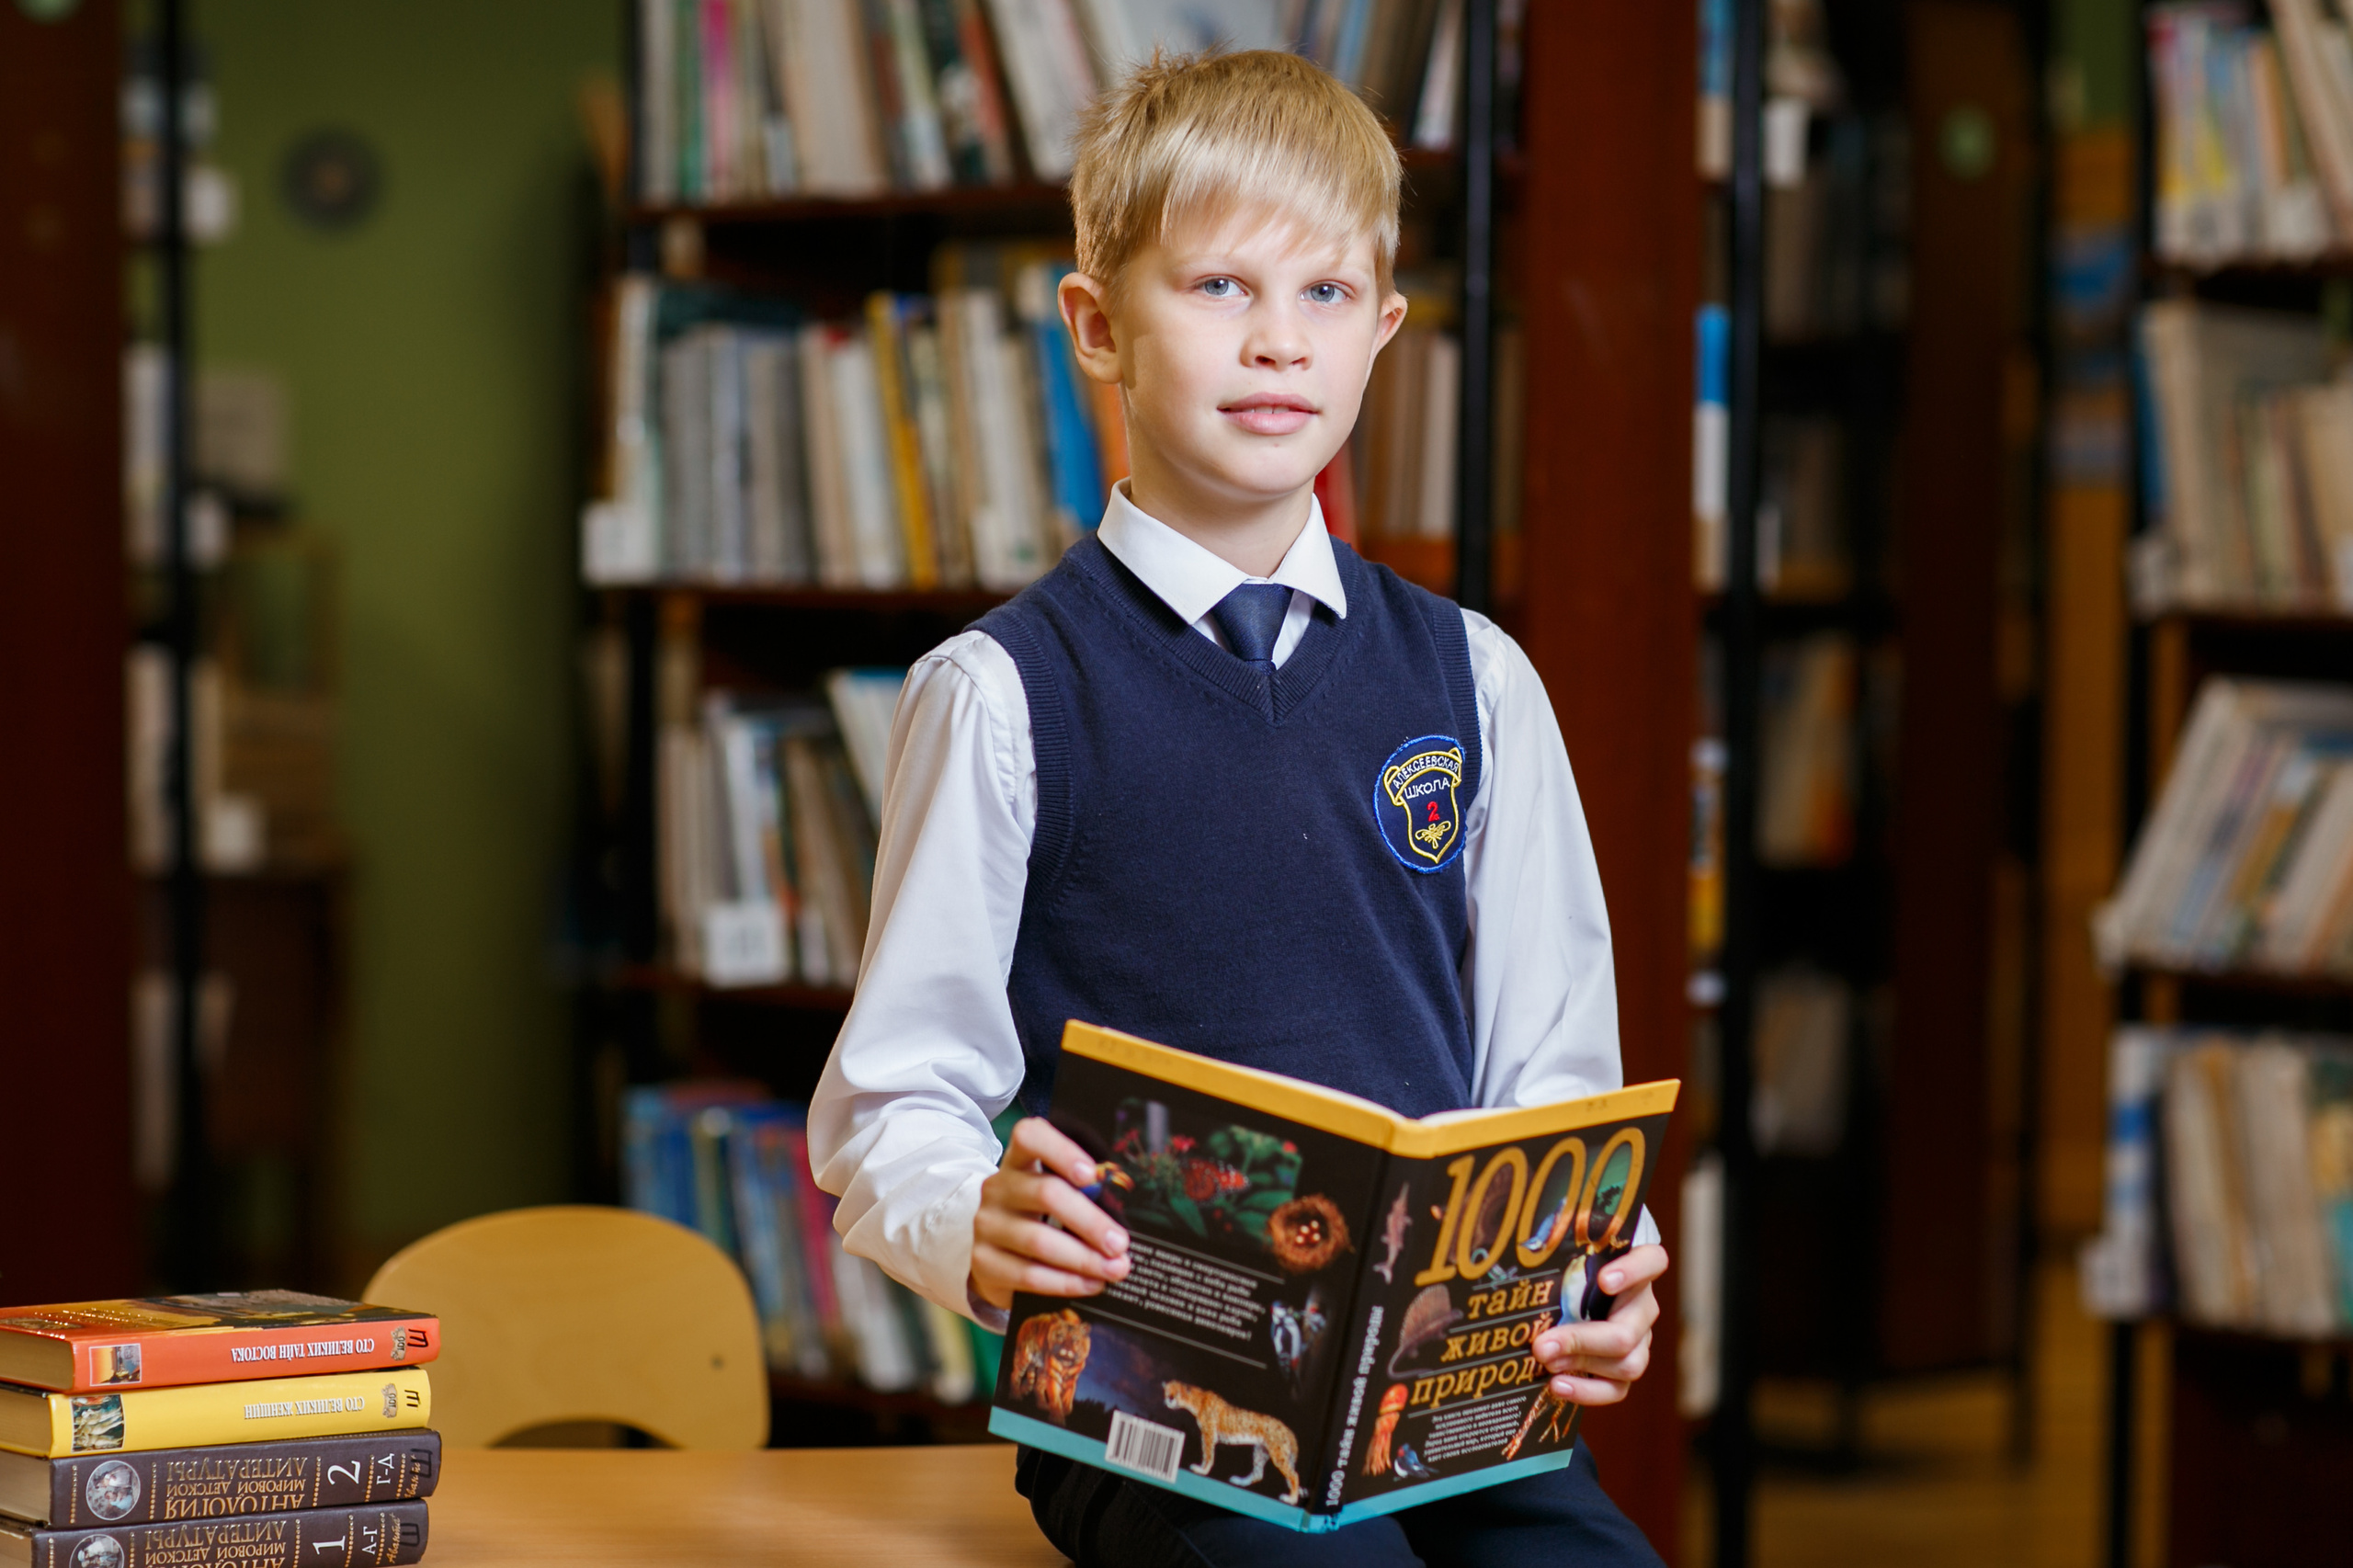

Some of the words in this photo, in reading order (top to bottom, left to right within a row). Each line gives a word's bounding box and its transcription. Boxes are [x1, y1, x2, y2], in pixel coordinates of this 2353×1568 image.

[1392, 756, 1460, 790] АЛЕКСЕЕВСКАЯ
[1404, 778, 1450, 800] ШКОЛА
[1427, 801, 1440, 823] 2
[1415, 1127, 1645, 1287] 1000
[1468, 1278, 1554, 1320] тайн
[355, 1337, 375, 1354] СТО
[1440, 1312, 1553, 1363] живой
[231, 1345, 276, 1364] ВОСТОКА
[278, 1343, 305, 1362] ТАЙН
[307, 1340, 353, 1358] ВЕЛИКИХ
[1410, 1357, 1542, 1408] природ
[244, 1402, 293, 1420] ЖЕНЩИН
[296, 1398, 343, 1415] ВЕЛИКИХ
[346, 1396, 366, 1413] СТО
[166, 1457, 308, 1483] ЛИТЕРАТУРЫ
[327, 1460, 361, 1485] 2
[376, 1453, 394, 1485] Г-Д
[165, 1481, 232, 1501] ДЕТСКОЙ
[237, 1479, 307, 1498] МИРОВОЙ
[1325, 1470, 1345, 1506] 1000
[163, 1494, 305, 1519] АНТОЛОГИЯ
[144, 1520, 287, 1551] ЛИТЕРАТУРЫ
[313, 1535, 347, 1556] 1
[361, 1526, 378, 1555] А-Г
[145, 1545, 210, 1567] ДЕТСКОЙ
[216, 1541, 286, 1562] МИРОВОЙ
